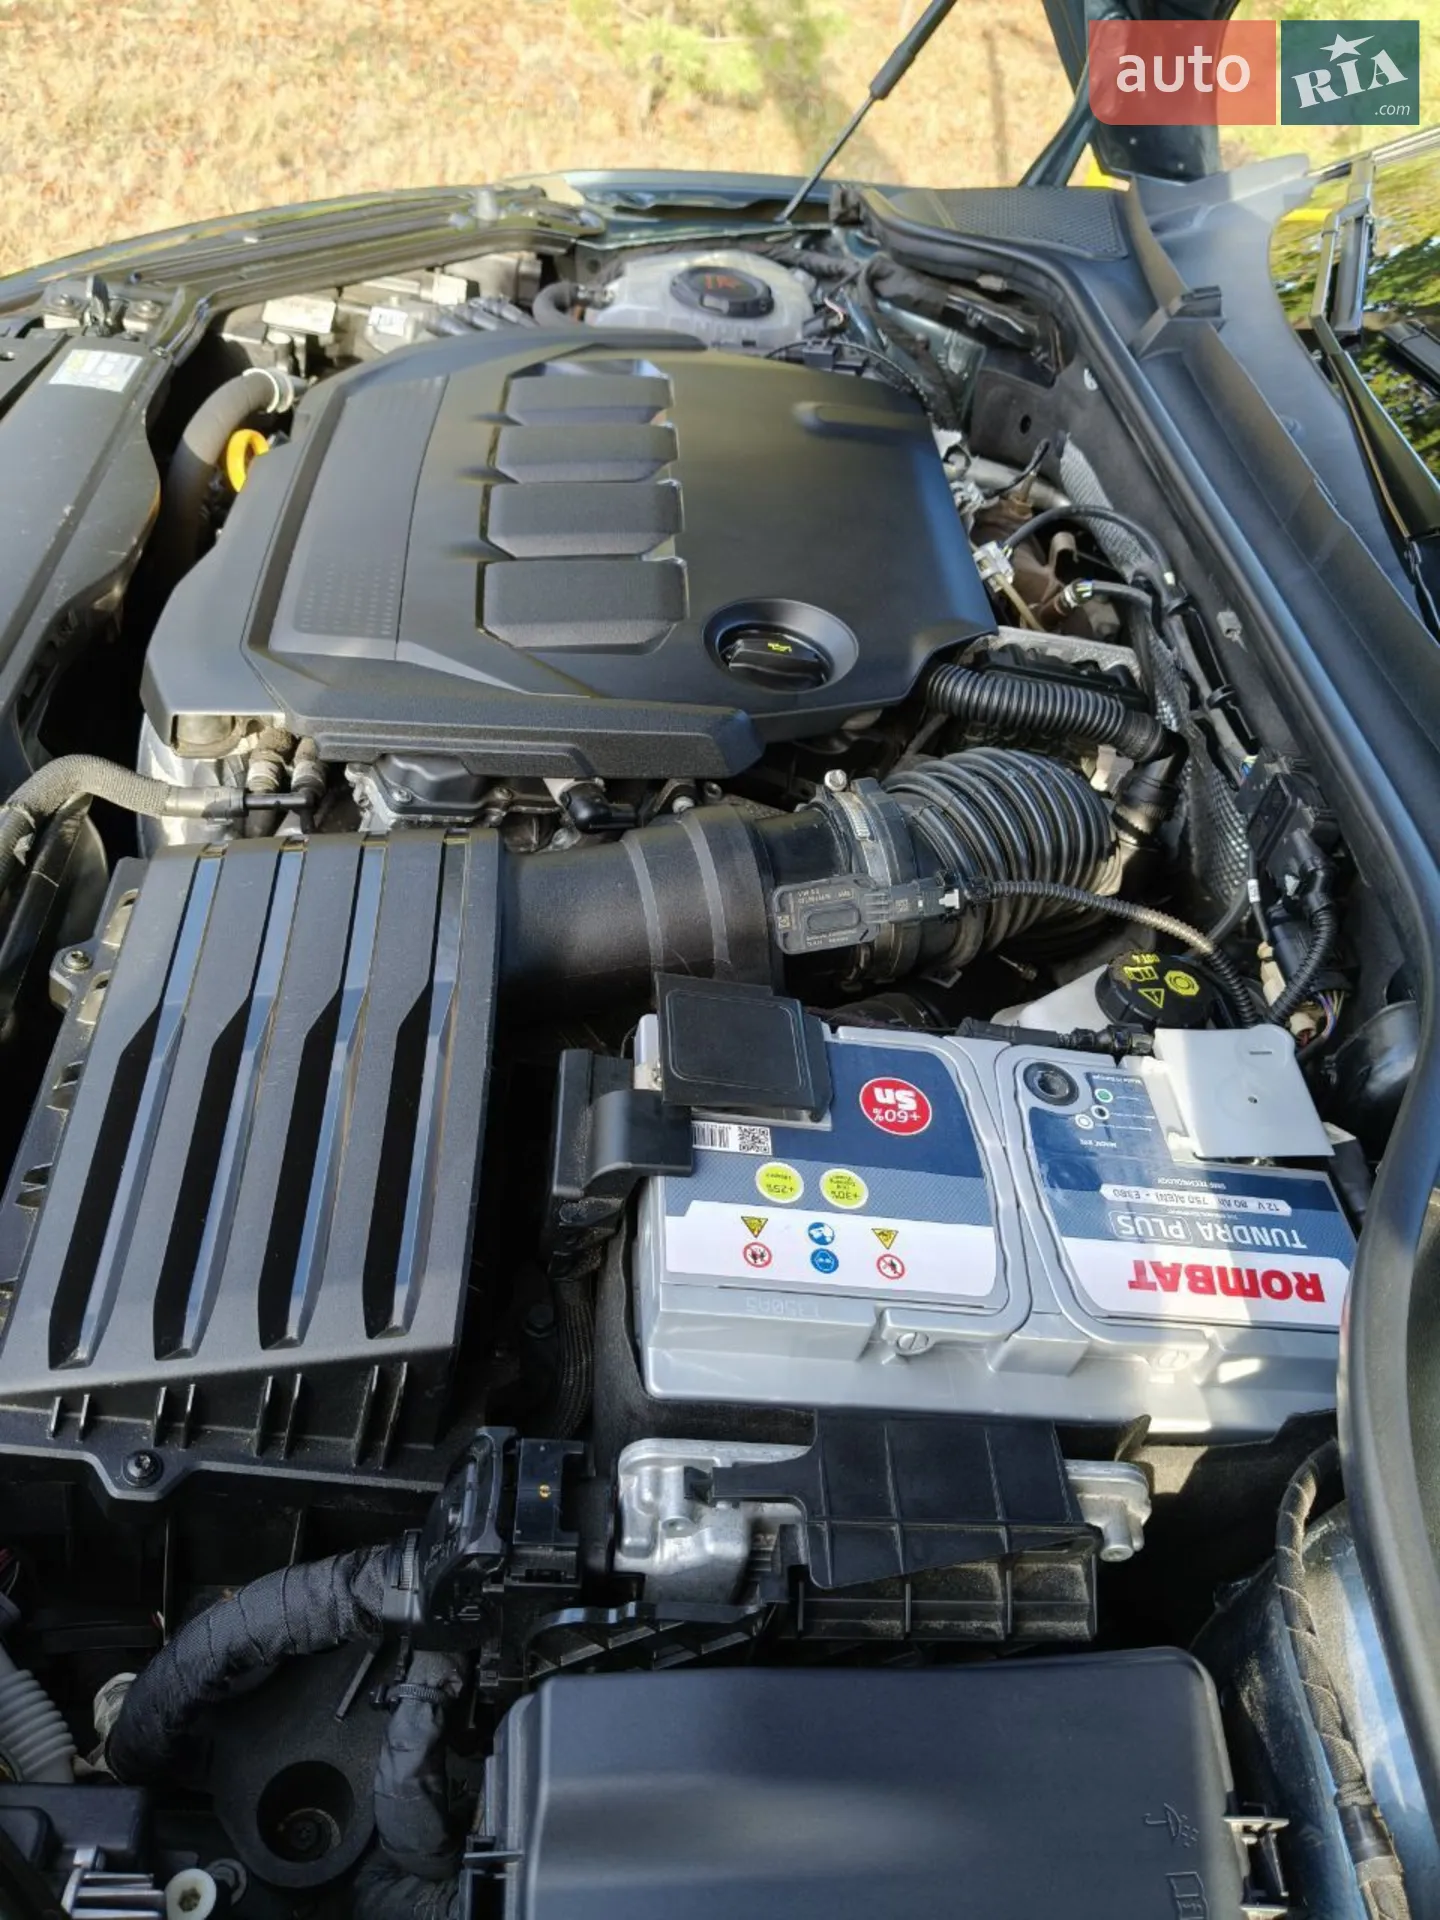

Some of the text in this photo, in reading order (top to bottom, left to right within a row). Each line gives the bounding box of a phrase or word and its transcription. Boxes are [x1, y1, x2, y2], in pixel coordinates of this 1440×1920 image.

[873, 1087, 917, 1111] Sn
[872, 1107, 921, 1123] +60%
[1116, 1214, 1308, 1250] TUNDRA PLUS
